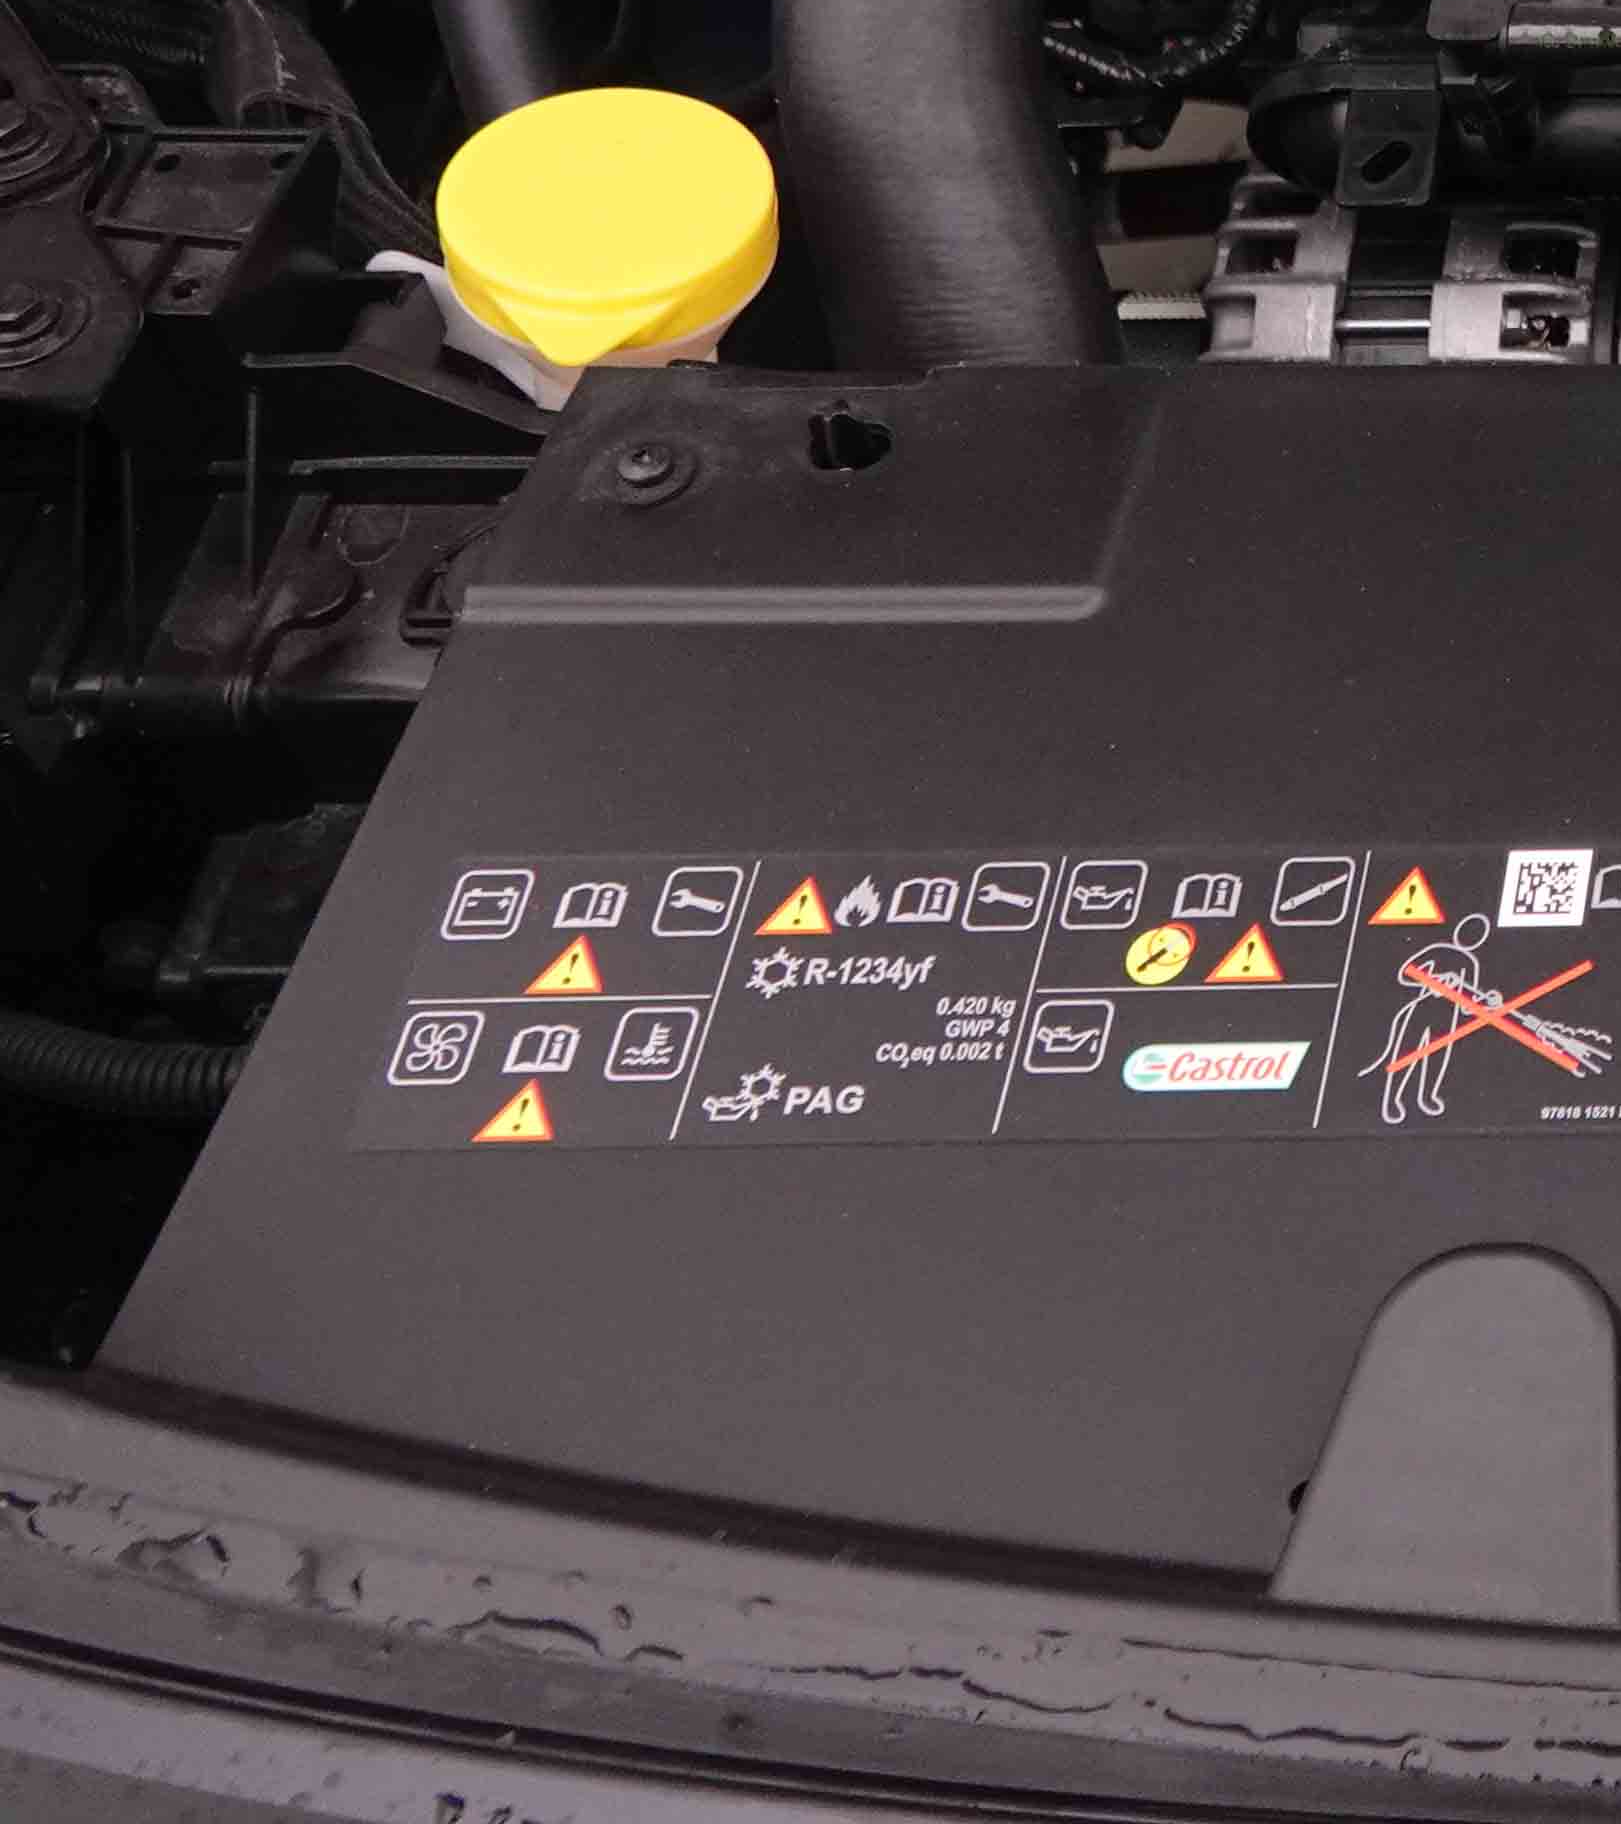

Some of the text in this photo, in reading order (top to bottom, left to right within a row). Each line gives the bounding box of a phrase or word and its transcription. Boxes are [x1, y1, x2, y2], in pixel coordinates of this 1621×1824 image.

[804, 956, 936, 988] R-1234yf
[936, 996, 1016, 1018] 0.420 kg
[944, 1019, 1010, 1038] GWP 4
[939, 1042, 992, 1061] 0.002
[995, 1042, 1004, 1060] t
[1168, 1050, 1291, 1084] Castrol
[783, 1084, 865, 1115] PAG
